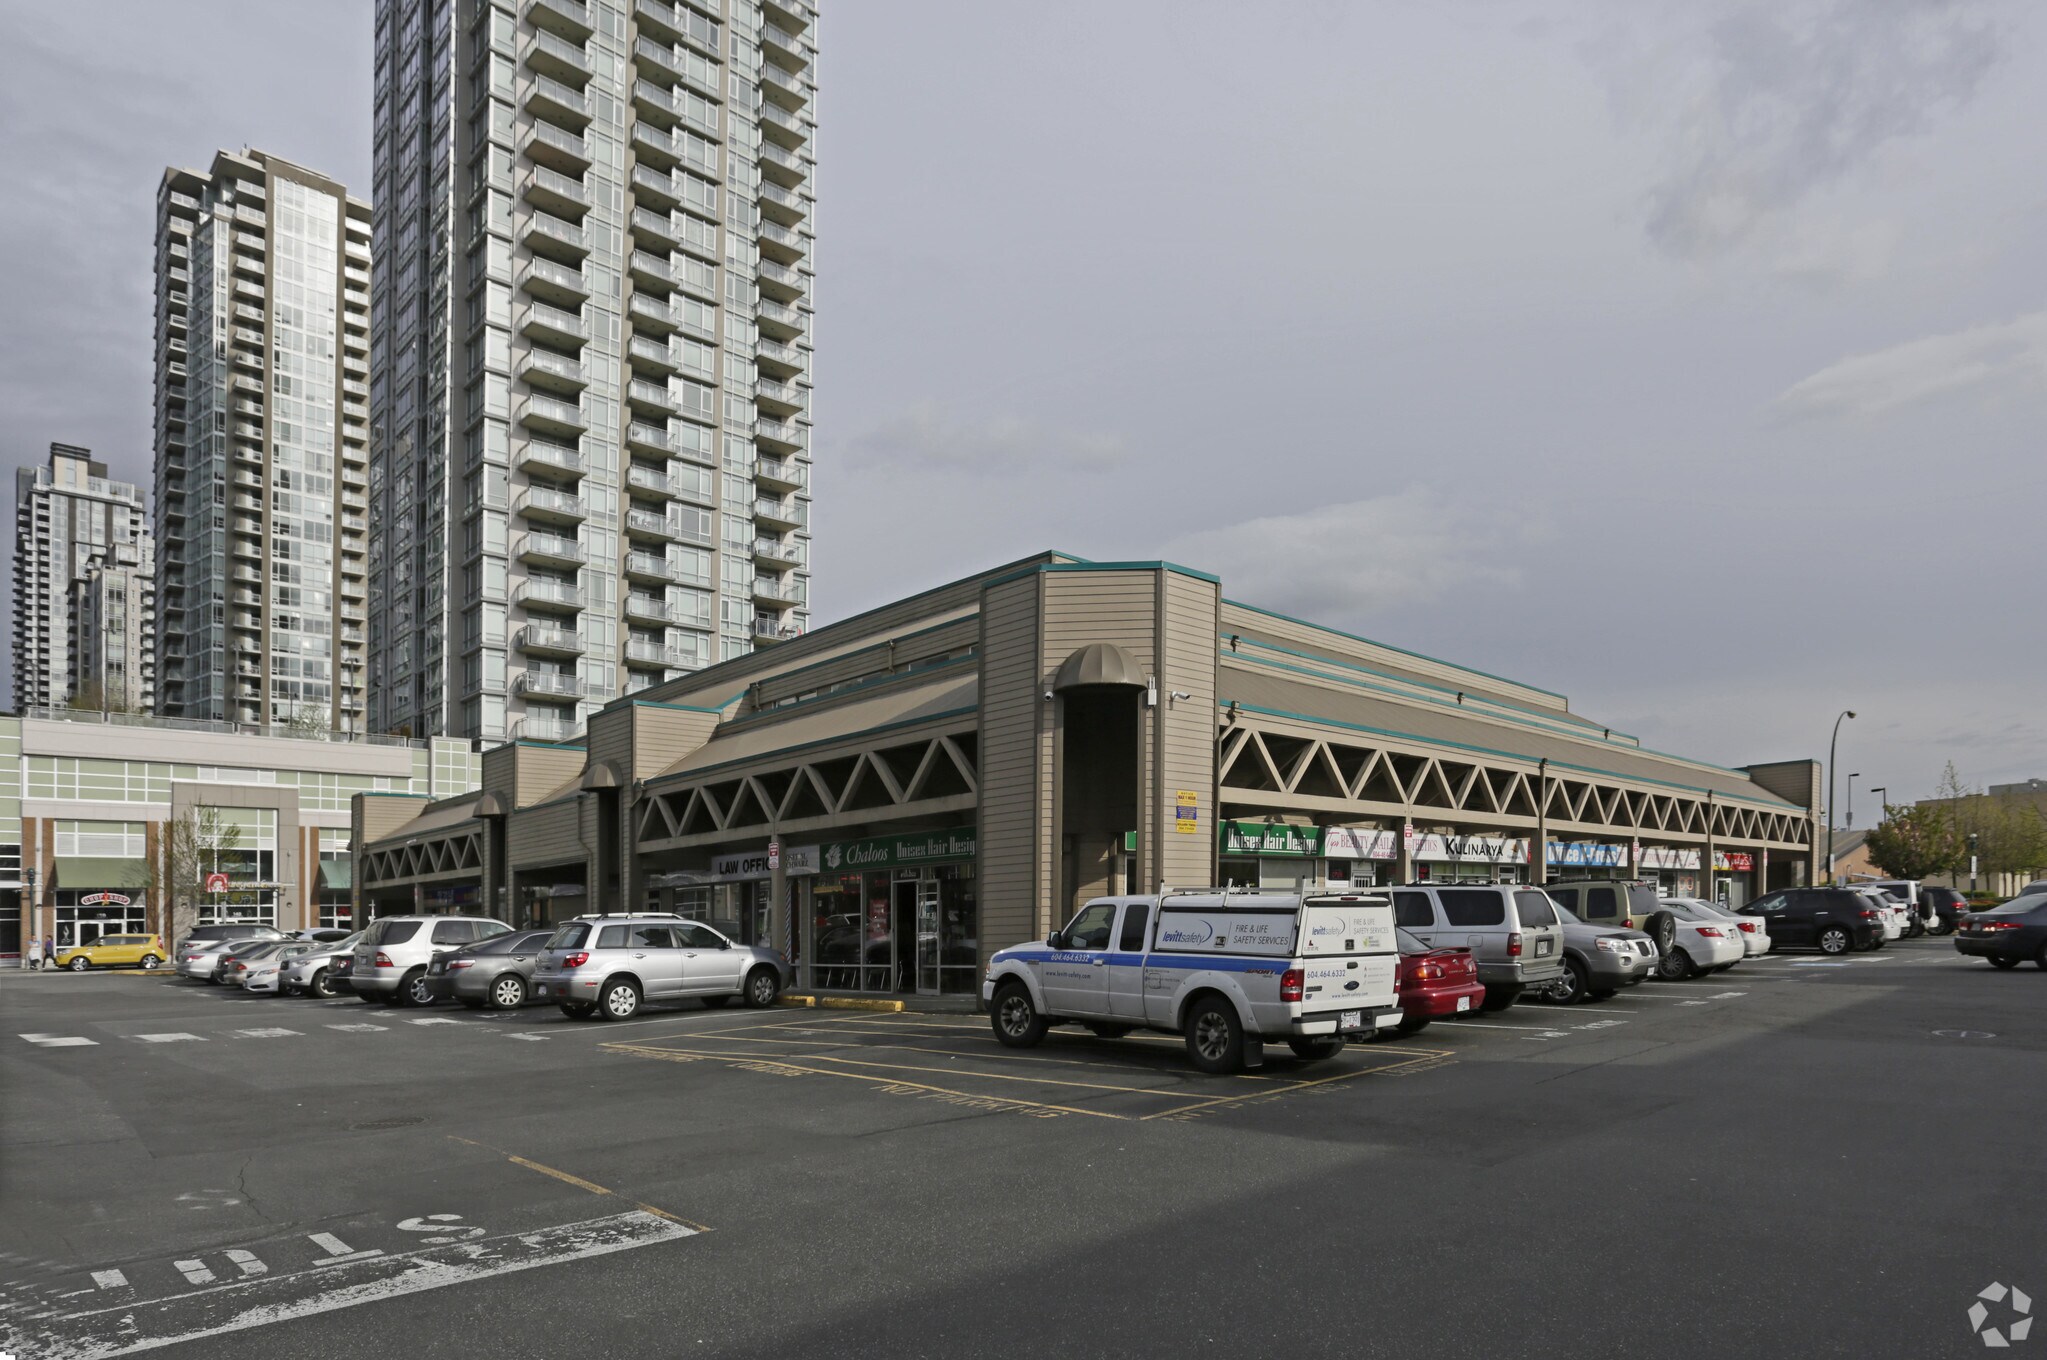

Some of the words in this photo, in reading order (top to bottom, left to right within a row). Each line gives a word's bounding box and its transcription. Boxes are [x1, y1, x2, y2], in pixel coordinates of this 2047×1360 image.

[897, 841, 926, 859] Unisex
[928, 838, 948, 856] Hair
[949, 836, 975, 856] Desig
[1228, 828, 1260, 849] Unisex
[1263, 830, 1285, 850] Hair
[1286, 831, 1317, 854] Design
[1340, 834, 1369, 849] BEAUTY
[1374, 837, 1395, 850] NAILS
[1412, 839, 1438, 852] THETICS
[846, 843, 889, 865] Chaloos
[719, 860, 738, 875] LAW
[742, 856, 771, 873] OFFIC
[1162, 929, 1205, 946] levittsafety
[1235, 924, 1248, 933] FIRE
[1249, 925, 1255, 933] &
[1256, 924, 1269, 934] LIFE
[1370, 927, 1389, 935] SERVICES
[1233, 935, 1256, 944] SAFETY
[1257, 936, 1289, 946] SERVICES
[1050, 953, 1090, 963] 604.464.6332
[1307, 969, 1346, 979] 604.464.6332
